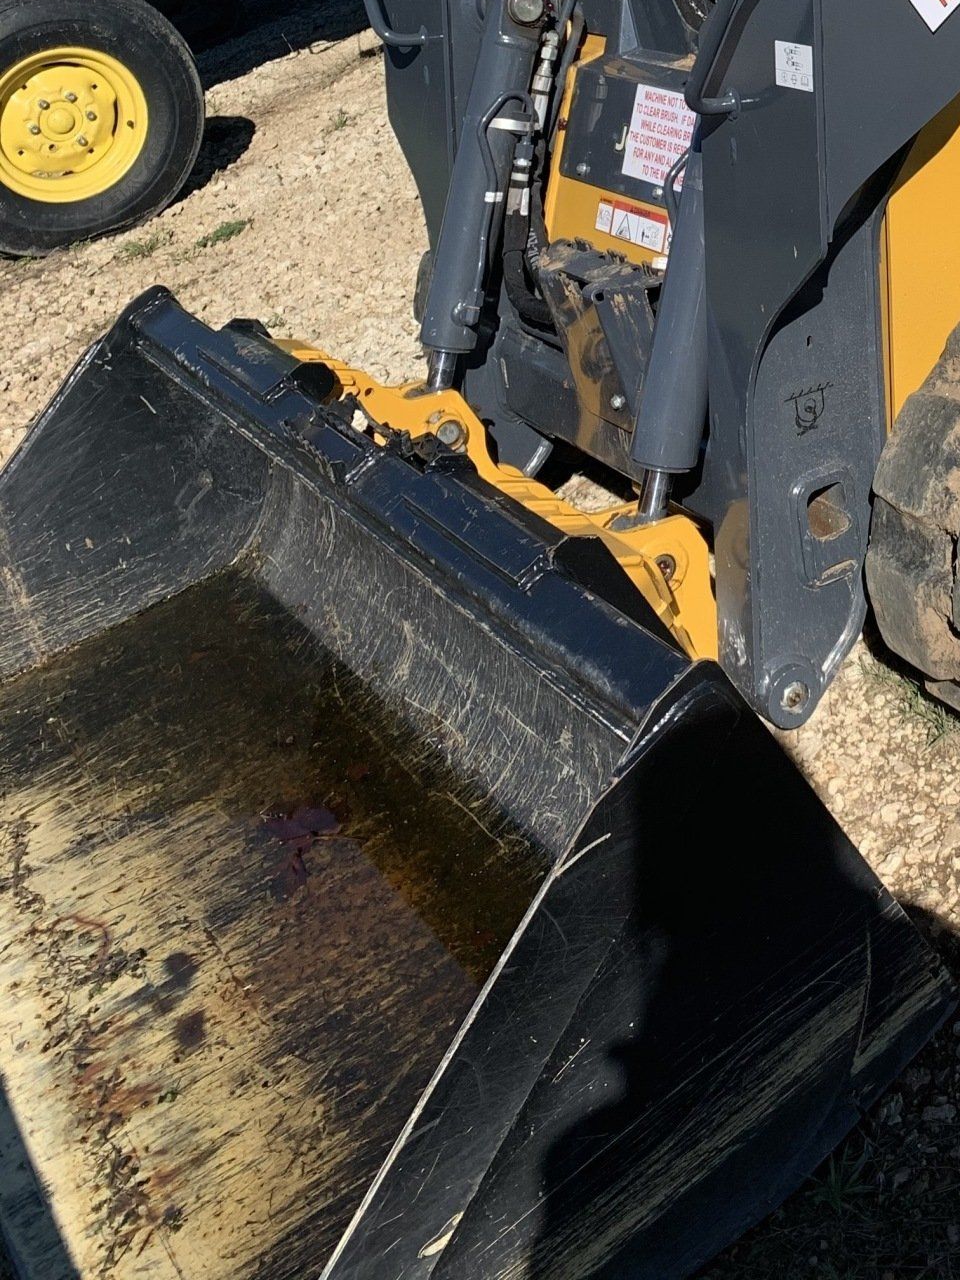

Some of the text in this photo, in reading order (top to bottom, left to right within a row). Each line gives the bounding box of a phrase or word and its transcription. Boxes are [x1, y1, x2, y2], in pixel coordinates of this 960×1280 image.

[644, 90, 667, 105] MACHINE
[667, 94, 679, 107] NOT
[636, 103, 643, 114] TO
[643, 105, 660, 118] CLEAR
[640, 120, 656, 133] WHILE
[656, 124, 682, 139] CLEARING
[630, 130, 639, 142] THE
[640, 134, 667, 150] CUSTOMER
[633, 147, 644, 158] FOR
[644, 149, 654, 161] ANY
[654, 152, 666, 164] AND
[642, 164, 649, 175] TO
[650, 166, 660, 178] THE
